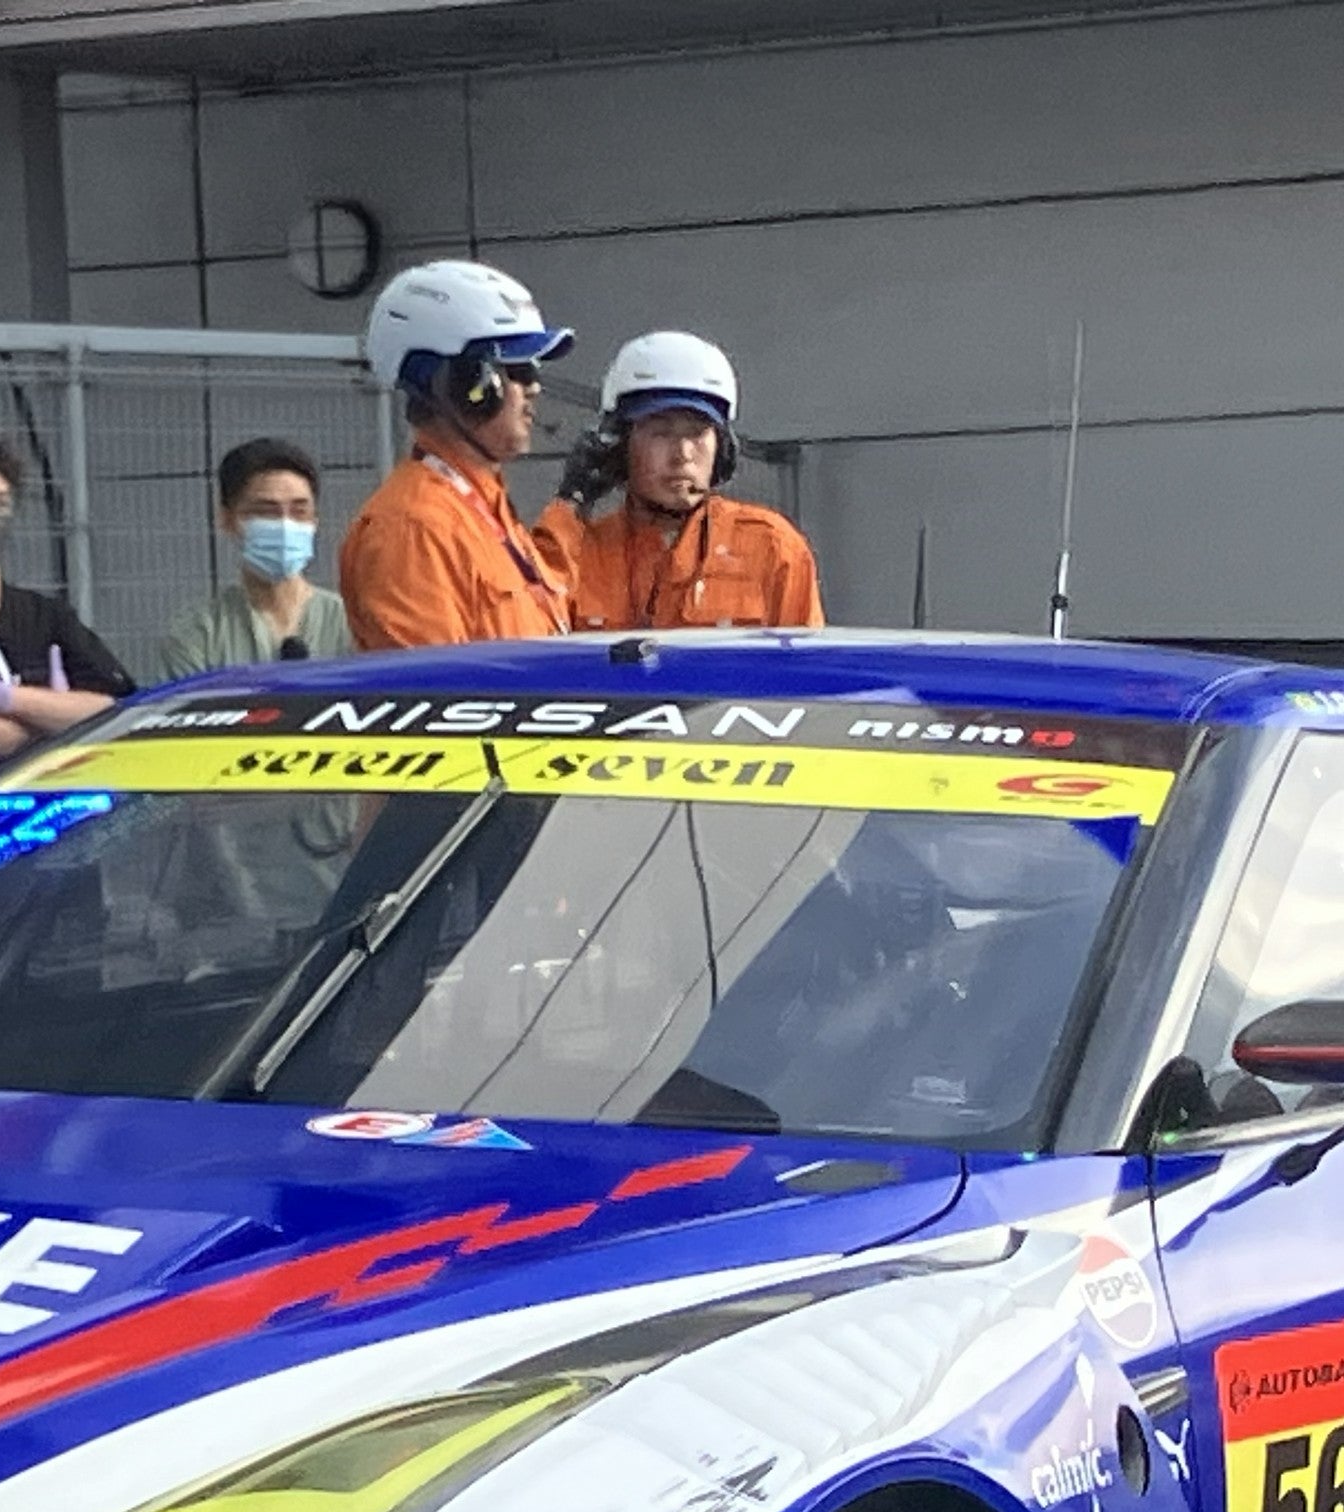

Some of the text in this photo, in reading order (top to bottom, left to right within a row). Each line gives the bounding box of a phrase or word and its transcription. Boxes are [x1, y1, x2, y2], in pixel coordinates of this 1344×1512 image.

[300, 701, 808, 738] NISSAN
[847, 717, 1076, 749] nismo
[220, 750, 797, 788] seven seven
[1084, 1270, 1145, 1305] PEPSI
